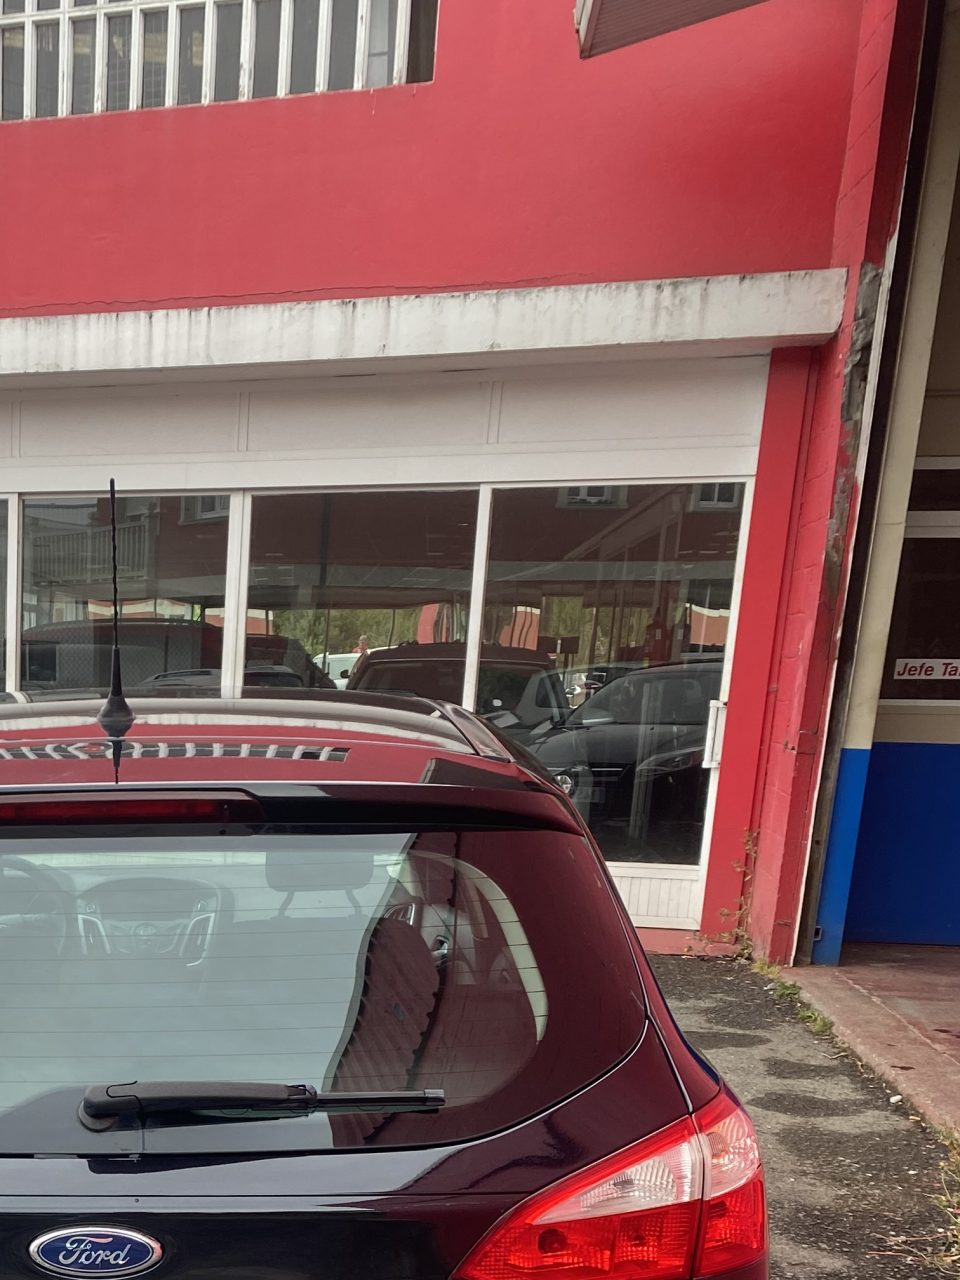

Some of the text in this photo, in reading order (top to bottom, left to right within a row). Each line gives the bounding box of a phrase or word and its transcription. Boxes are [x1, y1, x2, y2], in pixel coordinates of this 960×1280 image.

[897, 662, 960, 677] Jefe Ta
[58, 1236, 132, 1265] Ford
